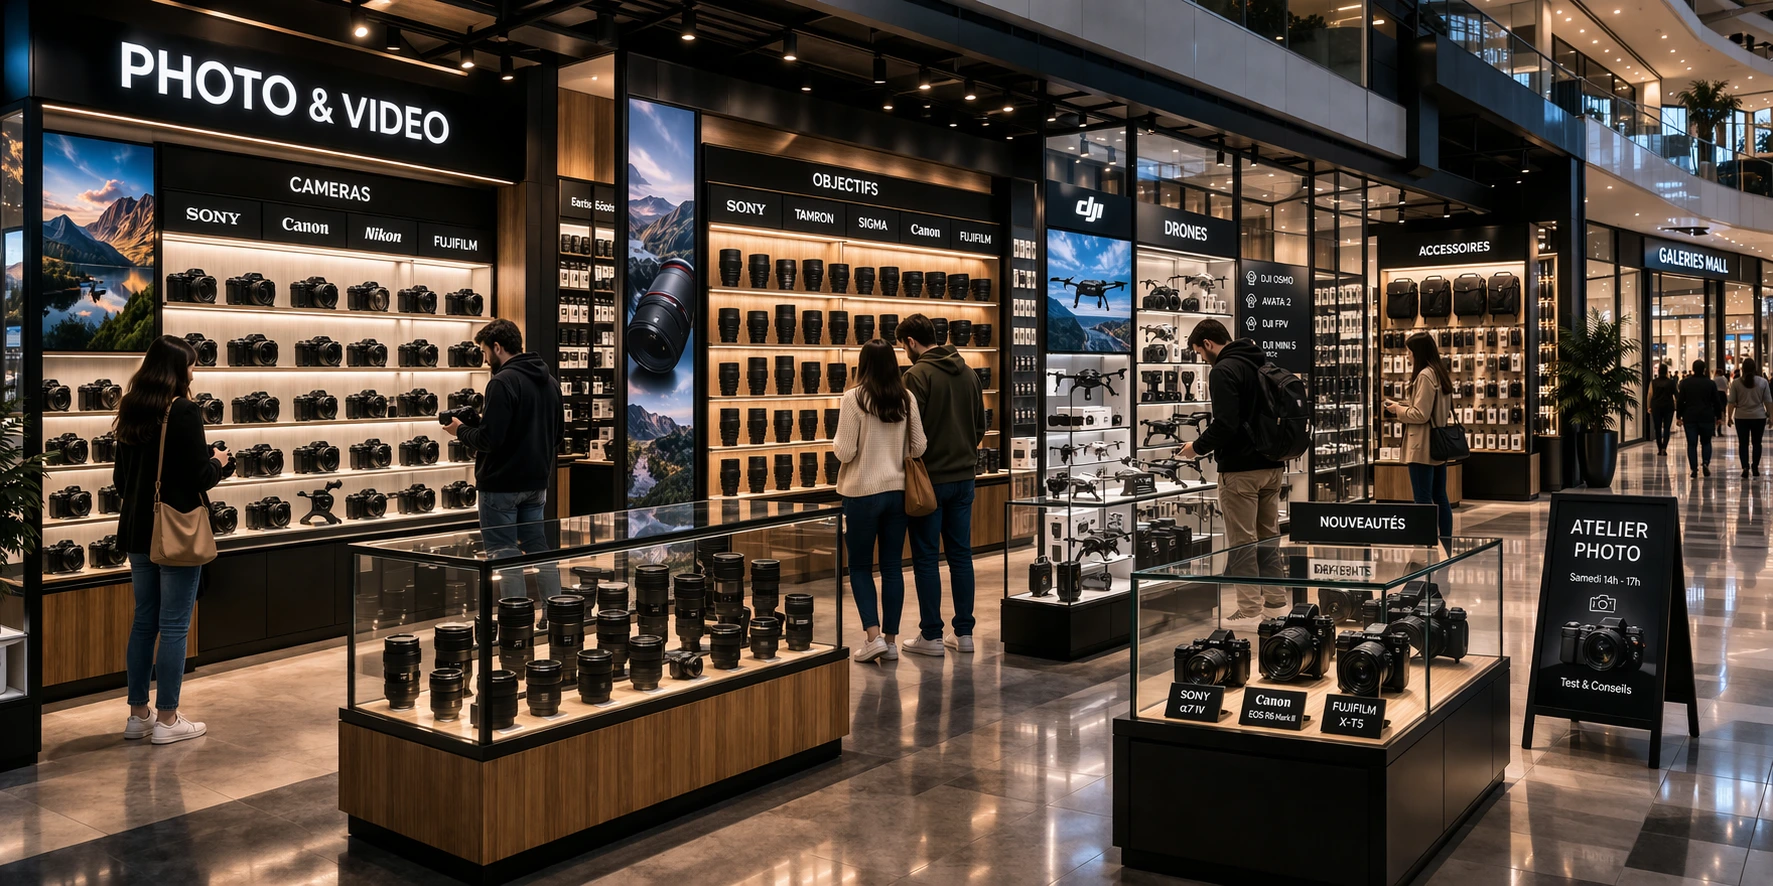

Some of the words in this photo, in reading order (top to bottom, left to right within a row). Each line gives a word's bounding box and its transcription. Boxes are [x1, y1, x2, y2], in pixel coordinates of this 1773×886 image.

[120, 42, 297, 116] PHOTO
[308, 88, 335, 124] &
[341, 93, 450, 144] VIDEO
[289, 177, 371, 201] CAMERAS
[813, 173, 882, 196] OBJECTIFS
[726, 200, 767, 215] SONY
[1075, 196, 1105, 222] dji
[186, 208, 242, 225] SONY
[794, 209, 834, 223] TAMRON
[281, 218, 329, 234] Canon
[858, 217, 888, 230] SIGMA
[910, 224, 941, 237] Canon
[1164, 220, 1208, 241] DRONES
[364, 227, 402, 242] Nikon
[959, 231, 992, 244] FUJIFILM
[434, 236, 478, 251] FUJIFILM
[1418, 241, 1491, 256] ACCESSOIRES
[1659, 247, 1704, 270] GALERIES
[1705, 256, 1729, 273] MALL
[1261, 275, 1271, 283] DJI
[1272, 275, 1294, 284] OSMO
[1262, 297, 1285, 305] AVATA
[1286, 298, 1291, 306] 2
[1263, 320, 1273, 328] DJI
[1275, 320, 1288, 328] FPV
[1263, 341, 1273, 349] DJI
[1320, 515, 1406, 529] NOUVEAUTÉS
[1570, 519, 1648, 538] ATELIER
[1574, 542, 1641, 561] PHOTO
[1569, 573, 1602, 583] Samedi
[1604, 576, 1618, 584] 14h
[1625, 577, 1641, 586] 17h
[1560, 677, 1581, 688] Test
[1581, 680, 1590, 689] &
[1591, 681, 1633, 696] Conseils
[1180, 690, 1211, 700] SONY
[1255, 695, 1291, 707] Canon
[1249, 710, 1264, 718] EOS
[1332, 702, 1377, 715] FUJIFILM
[1339, 717, 1364, 728] X-T5
